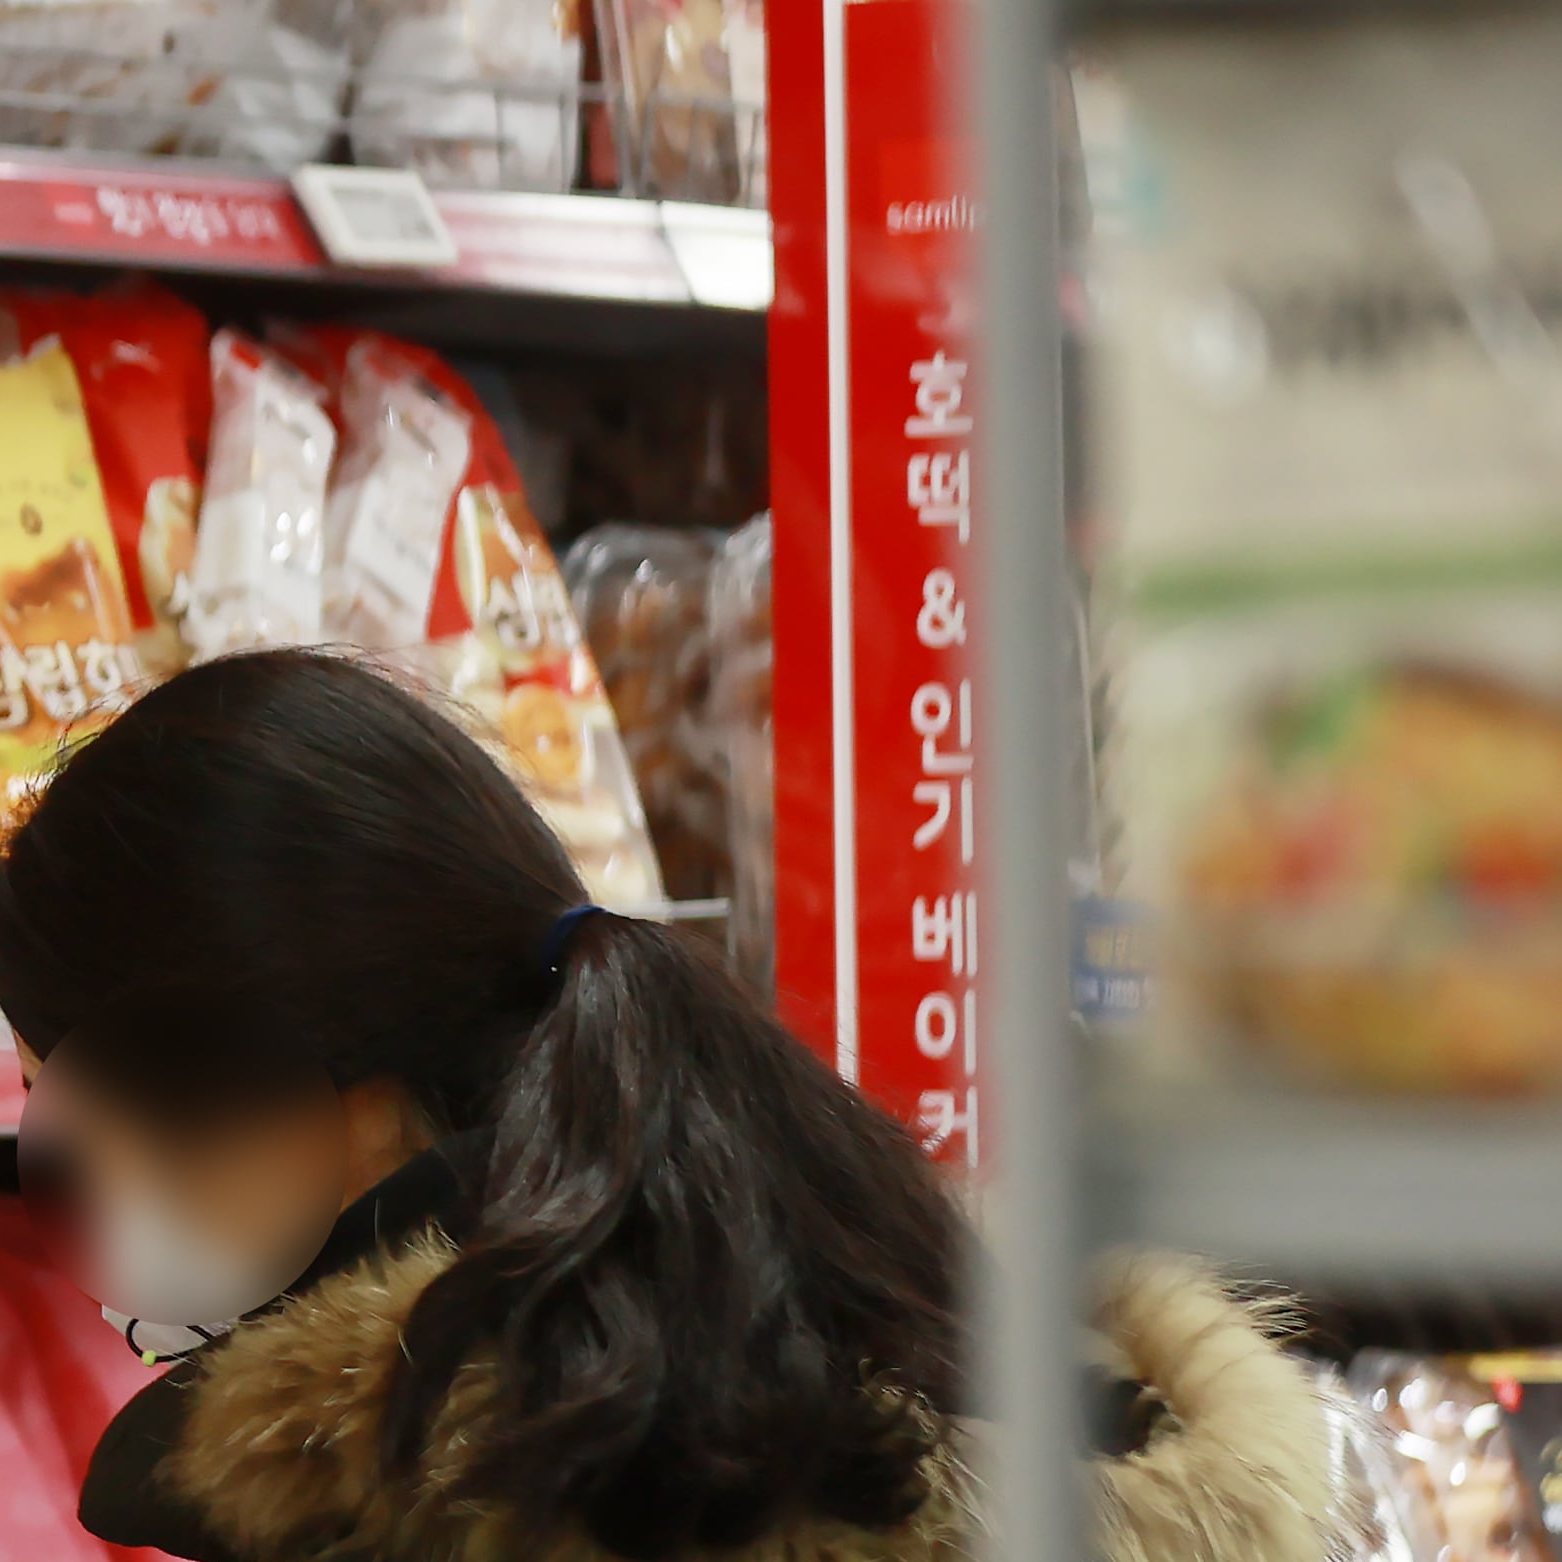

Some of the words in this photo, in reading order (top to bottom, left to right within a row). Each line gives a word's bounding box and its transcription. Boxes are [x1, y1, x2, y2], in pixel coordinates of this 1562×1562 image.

[904, 349, 973, 544] 호떡
[916, 568, 967, 650] &
[911, 678, 974, 866] 인기
